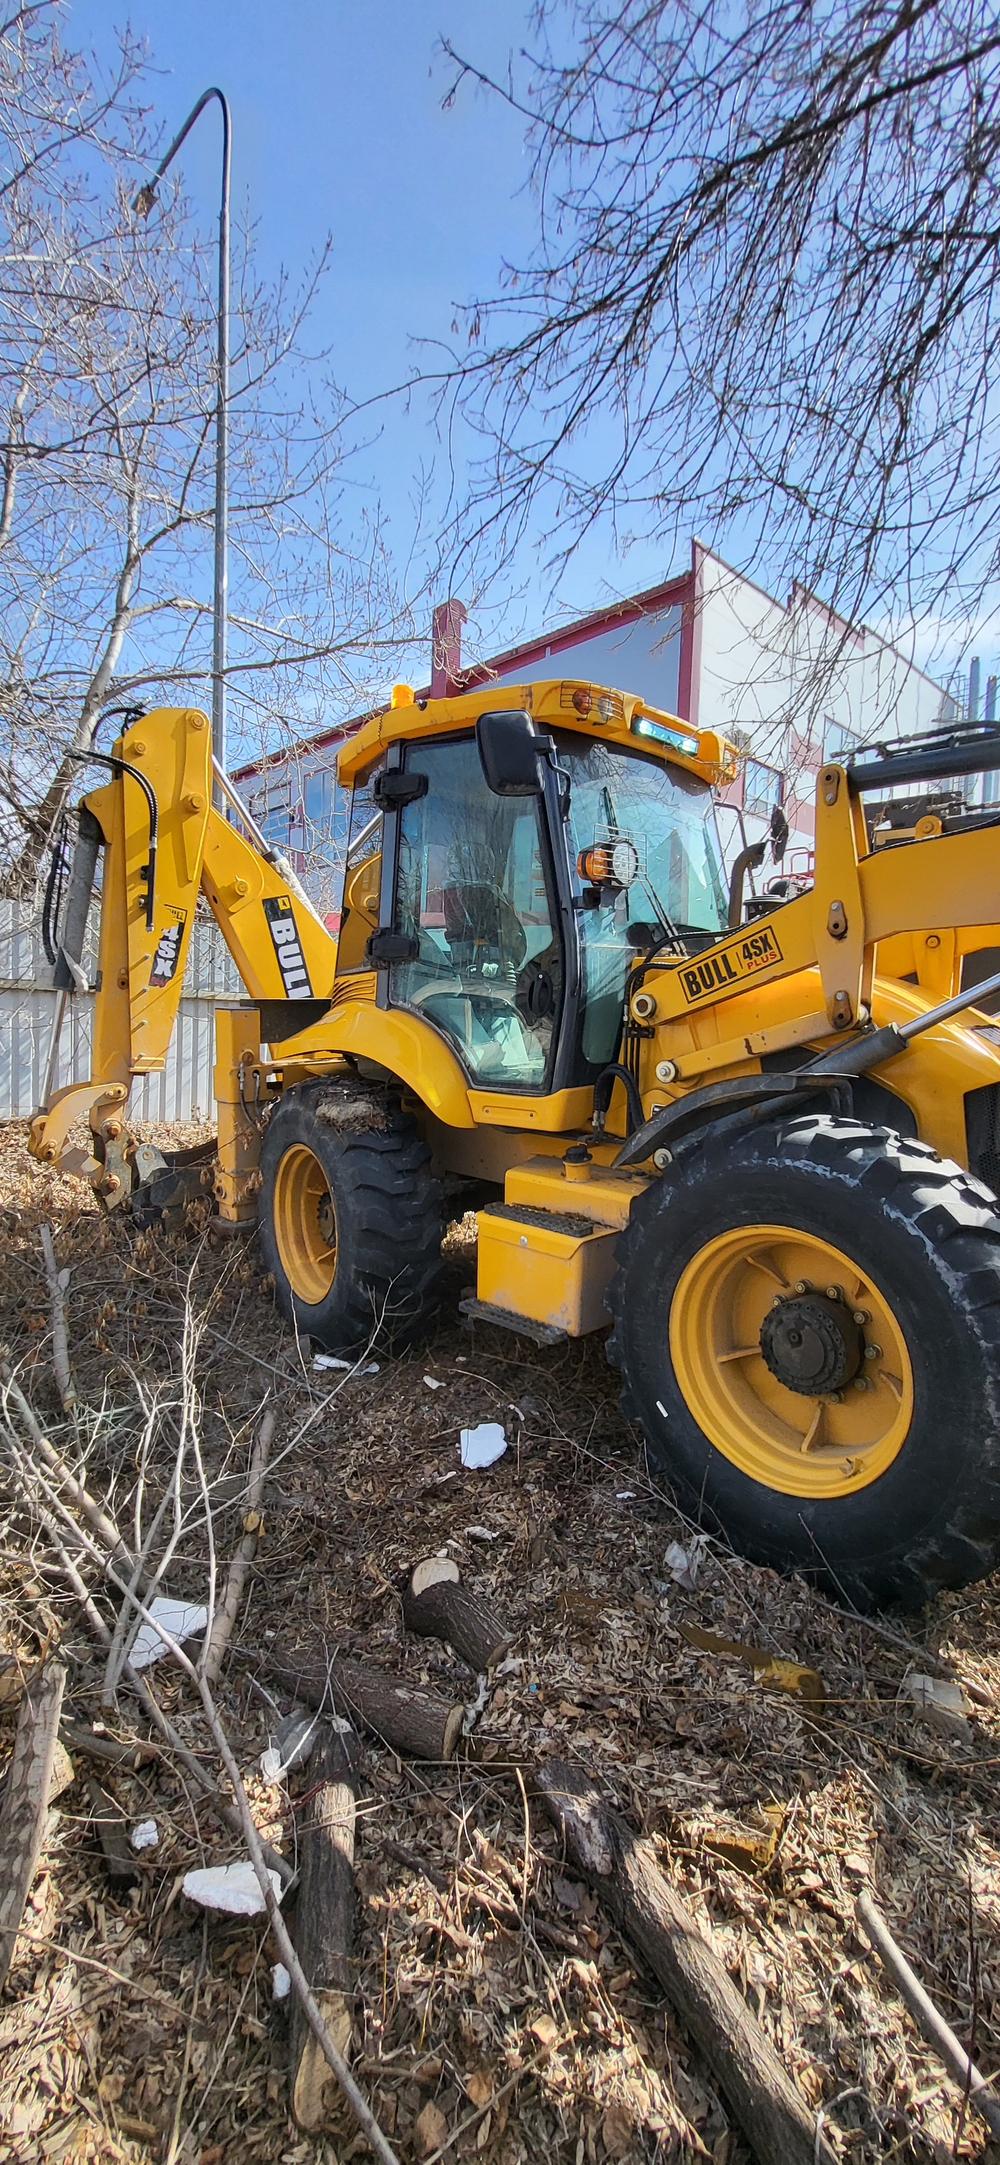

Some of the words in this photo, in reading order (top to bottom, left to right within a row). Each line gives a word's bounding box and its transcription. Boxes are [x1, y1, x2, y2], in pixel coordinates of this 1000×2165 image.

[154, 923, 179, 978] 4SX
[270, 918, 312, 998] BULL
[683, 953, 738, 998] BULL
[742, 933, 773, 961] 4SX
[746, 951, 778, 970] PLUS
